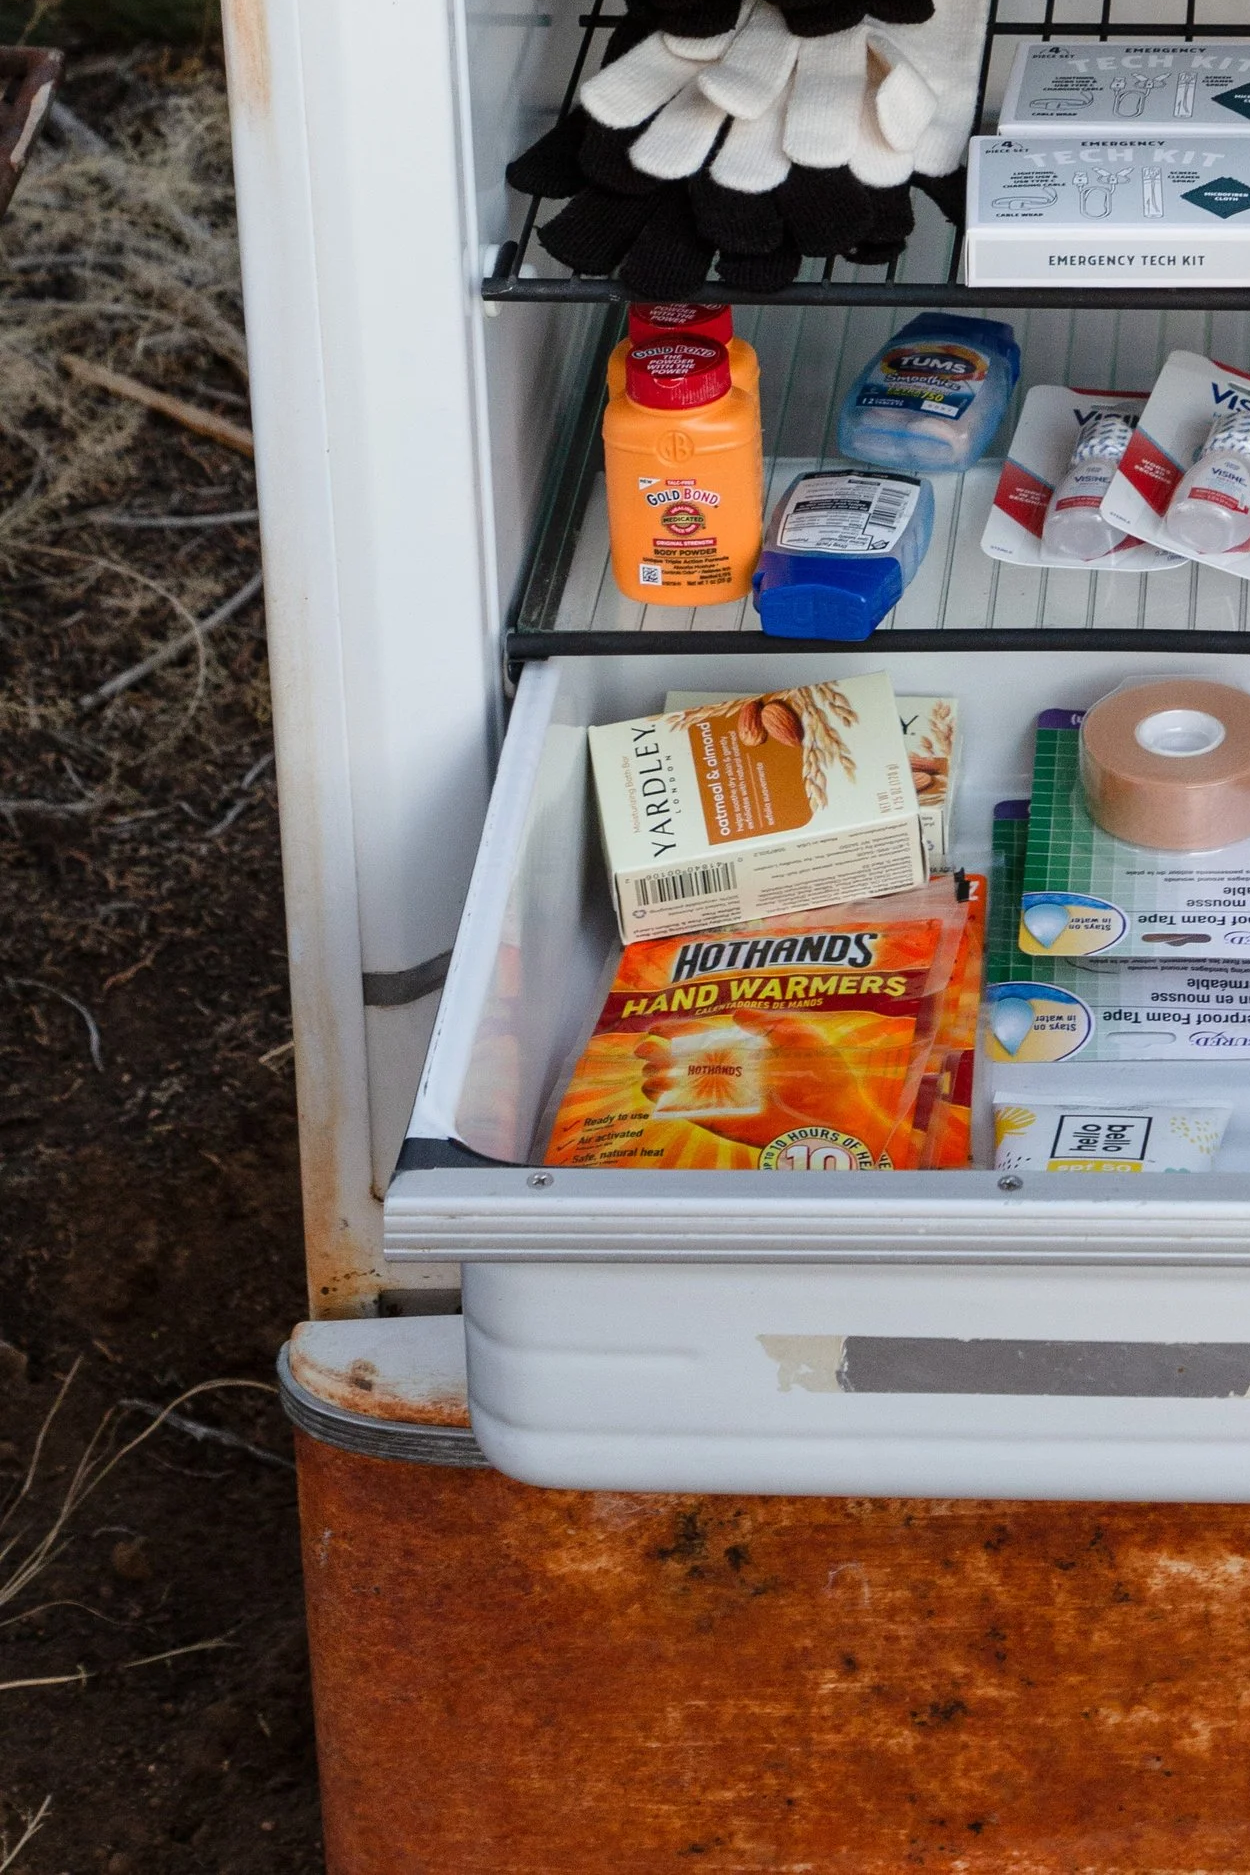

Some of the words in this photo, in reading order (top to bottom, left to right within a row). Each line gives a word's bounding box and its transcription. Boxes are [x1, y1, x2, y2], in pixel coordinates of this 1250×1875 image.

[1068, 55, 1174, 73] TECH
[1023, 147, 1135, 169] TECH
[1153, 149, 1227, 168] KIT
[1049, 255, 1135, 267] EMERGENCY
[1142, 255, 1178, 267] TECH
[1183, 255, 1206, 267] KIT
[632, 346, 674, 360] GOLD
[674, 344, 717, 358] BOND
[901, 355, 967, 374] TUMS
[884, 373, 962, 392] Smoothies
[646, 489, 680, 507] GOLD
[683, 487, 719, 506] BOND
[679, 548, 717, 556] POWDER
[696, 721, 717, 767] almond
[622, 770, 636, 788] Bath
[706, 768, 720, 780] &
[631, 727, 676, 858] YARDLEY
[665, 754, 682, 814] LONDON
[625, 788, 641, 834] Moisturizing
[706, 781, 732, 836] oatmeal
[1186, 898, 1247, 907] mousse
[1138, 914, 1175, 924] Tape
[1179, 915, 1226, 925] Foam
[672, 933, 878, 983] HOTHANDS
[622, 983, 719, 1018] HAND
[730, 976, 908, 1001] WARMERS
[1151, 992, 1212, 1004] mousse
[1216, 995, 1234, 1005] en
[695, 1002, 770, 1016] CALENTADORES
[773, 1002, 786, 1011] DE
[789, 998, 823, 1009] MANOS
[1103, 1011, 1141, 1023] Tape
[1146, 1013, 1191, 1024] Foam
[688, 1065, 742, 1077] HOTHANDS
[584, 1115, 615, 1128] Ready
[618, 1114, 627, 1123] to
[629, 1113, 650, 1122] use
[578, 1134, 595, 1145] Air
[598, 1128, 643, 1143] activated
[788, 1127, 839, 1143] HOURS
[843, 1135, 860, 1150] OF
[1069, 1124, 1102, 1152] hello
[1102, 1124, 1135, 1152] bello
[572, 1153, 598, 1165] Safe,
[600, 1149, 637, 1160] natural
[639, 1146, 664, 1158] heat
[1058, 1162, 1095, 1172] spf
[1102, 1163, 1132, 1172] 50
